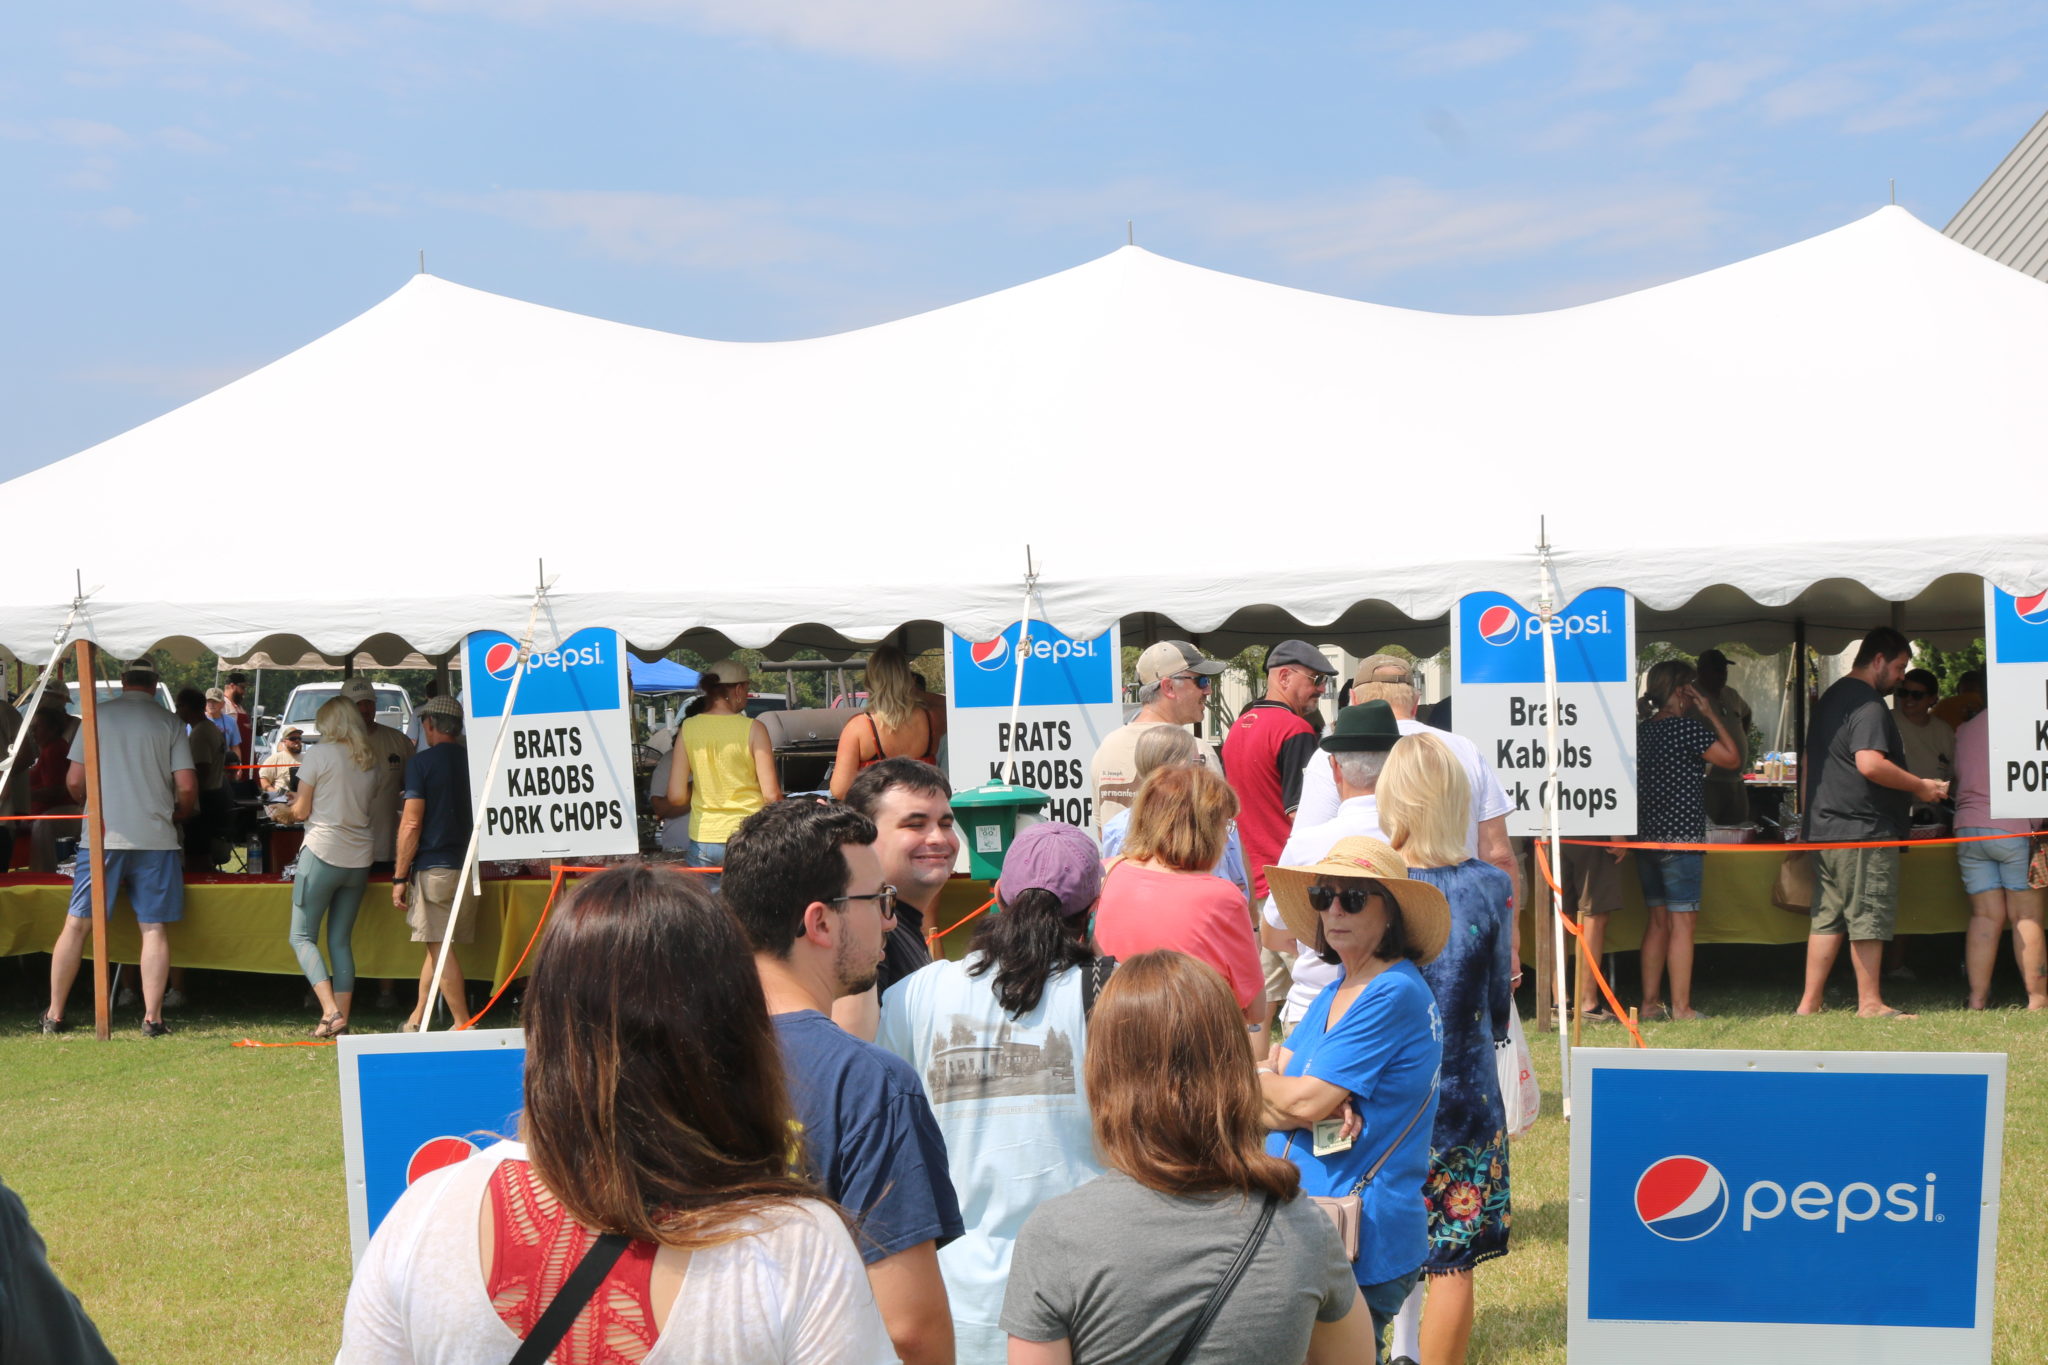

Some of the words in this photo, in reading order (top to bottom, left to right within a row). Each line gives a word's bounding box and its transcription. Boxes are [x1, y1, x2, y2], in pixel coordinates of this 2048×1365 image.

[1525, 609, 1608, 641] pepsi
[526, 642, 600, 674] pepsi
[513, 726, 583, 760] BRATS
[998, 720, 1072, 753] BRATS
[507, 763, 594, 798] KABOBS
[990, 758, 1084, 790] KABOBS
[1101, 788, 1136, 798] germanfes
[486, 804, 545, 836] PORK
[549, 799, 623, 834] CHOPS
[1040, 797, 1093, 827] HOP
[1743, 1172, 1938, 1234] pepsi
